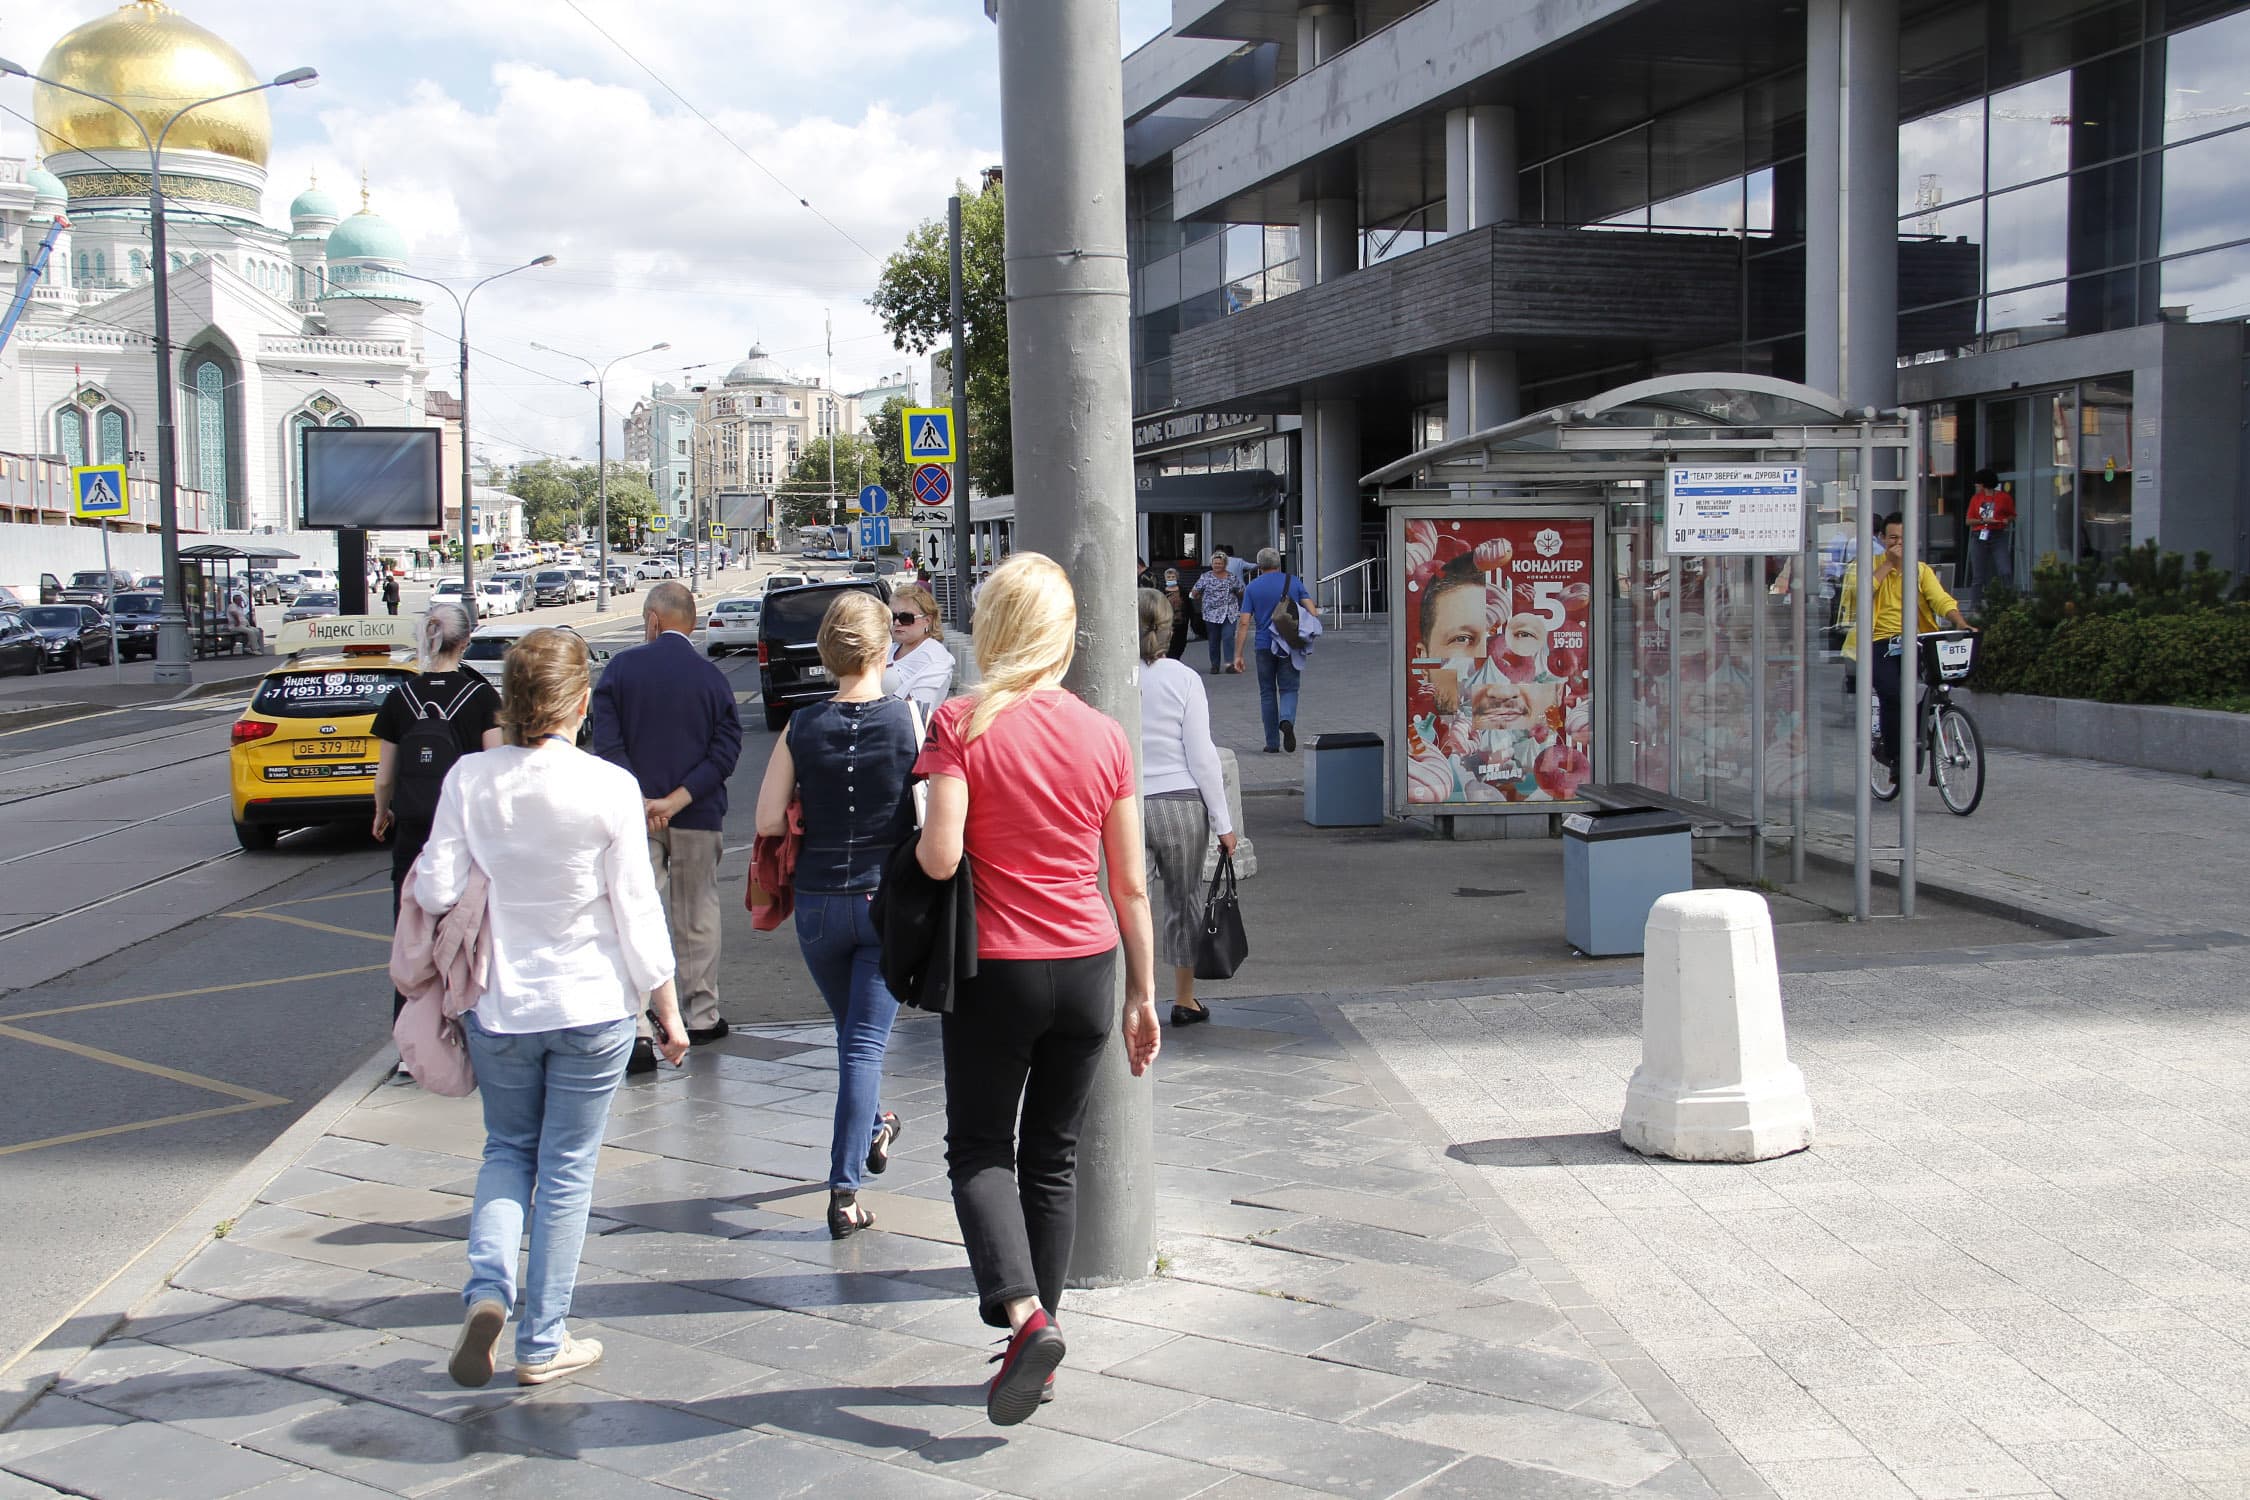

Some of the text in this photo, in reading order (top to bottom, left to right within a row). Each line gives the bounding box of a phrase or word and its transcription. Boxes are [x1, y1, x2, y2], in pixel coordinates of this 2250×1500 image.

[1754, 471, 1781, 480] ДУРОВА
[1679, 503, 1684, 516] 7
[1675, 529, 1686, 542] 50
[1512, 560, 1583, 572] КОНДИТЕР
[1534, 582, 1566, 632] 5
[308, 620, 394, 639] Яндекс Такси
[1553, 638, 1583, 649] 19:00
[1949, 645, 1967, 654] ВТБ
[283, 675, 322, 686] Яндекс
[349, 673, 379, 682] Такси
[264, 689, 281, 699] +7
[284, 686, 322, 698] (495)
[326, 684, 352, 695] 999
[355, 684, 374, 694] 99
[320, 741, 342, 753] 379
[350, 741, 361, 750] 77
